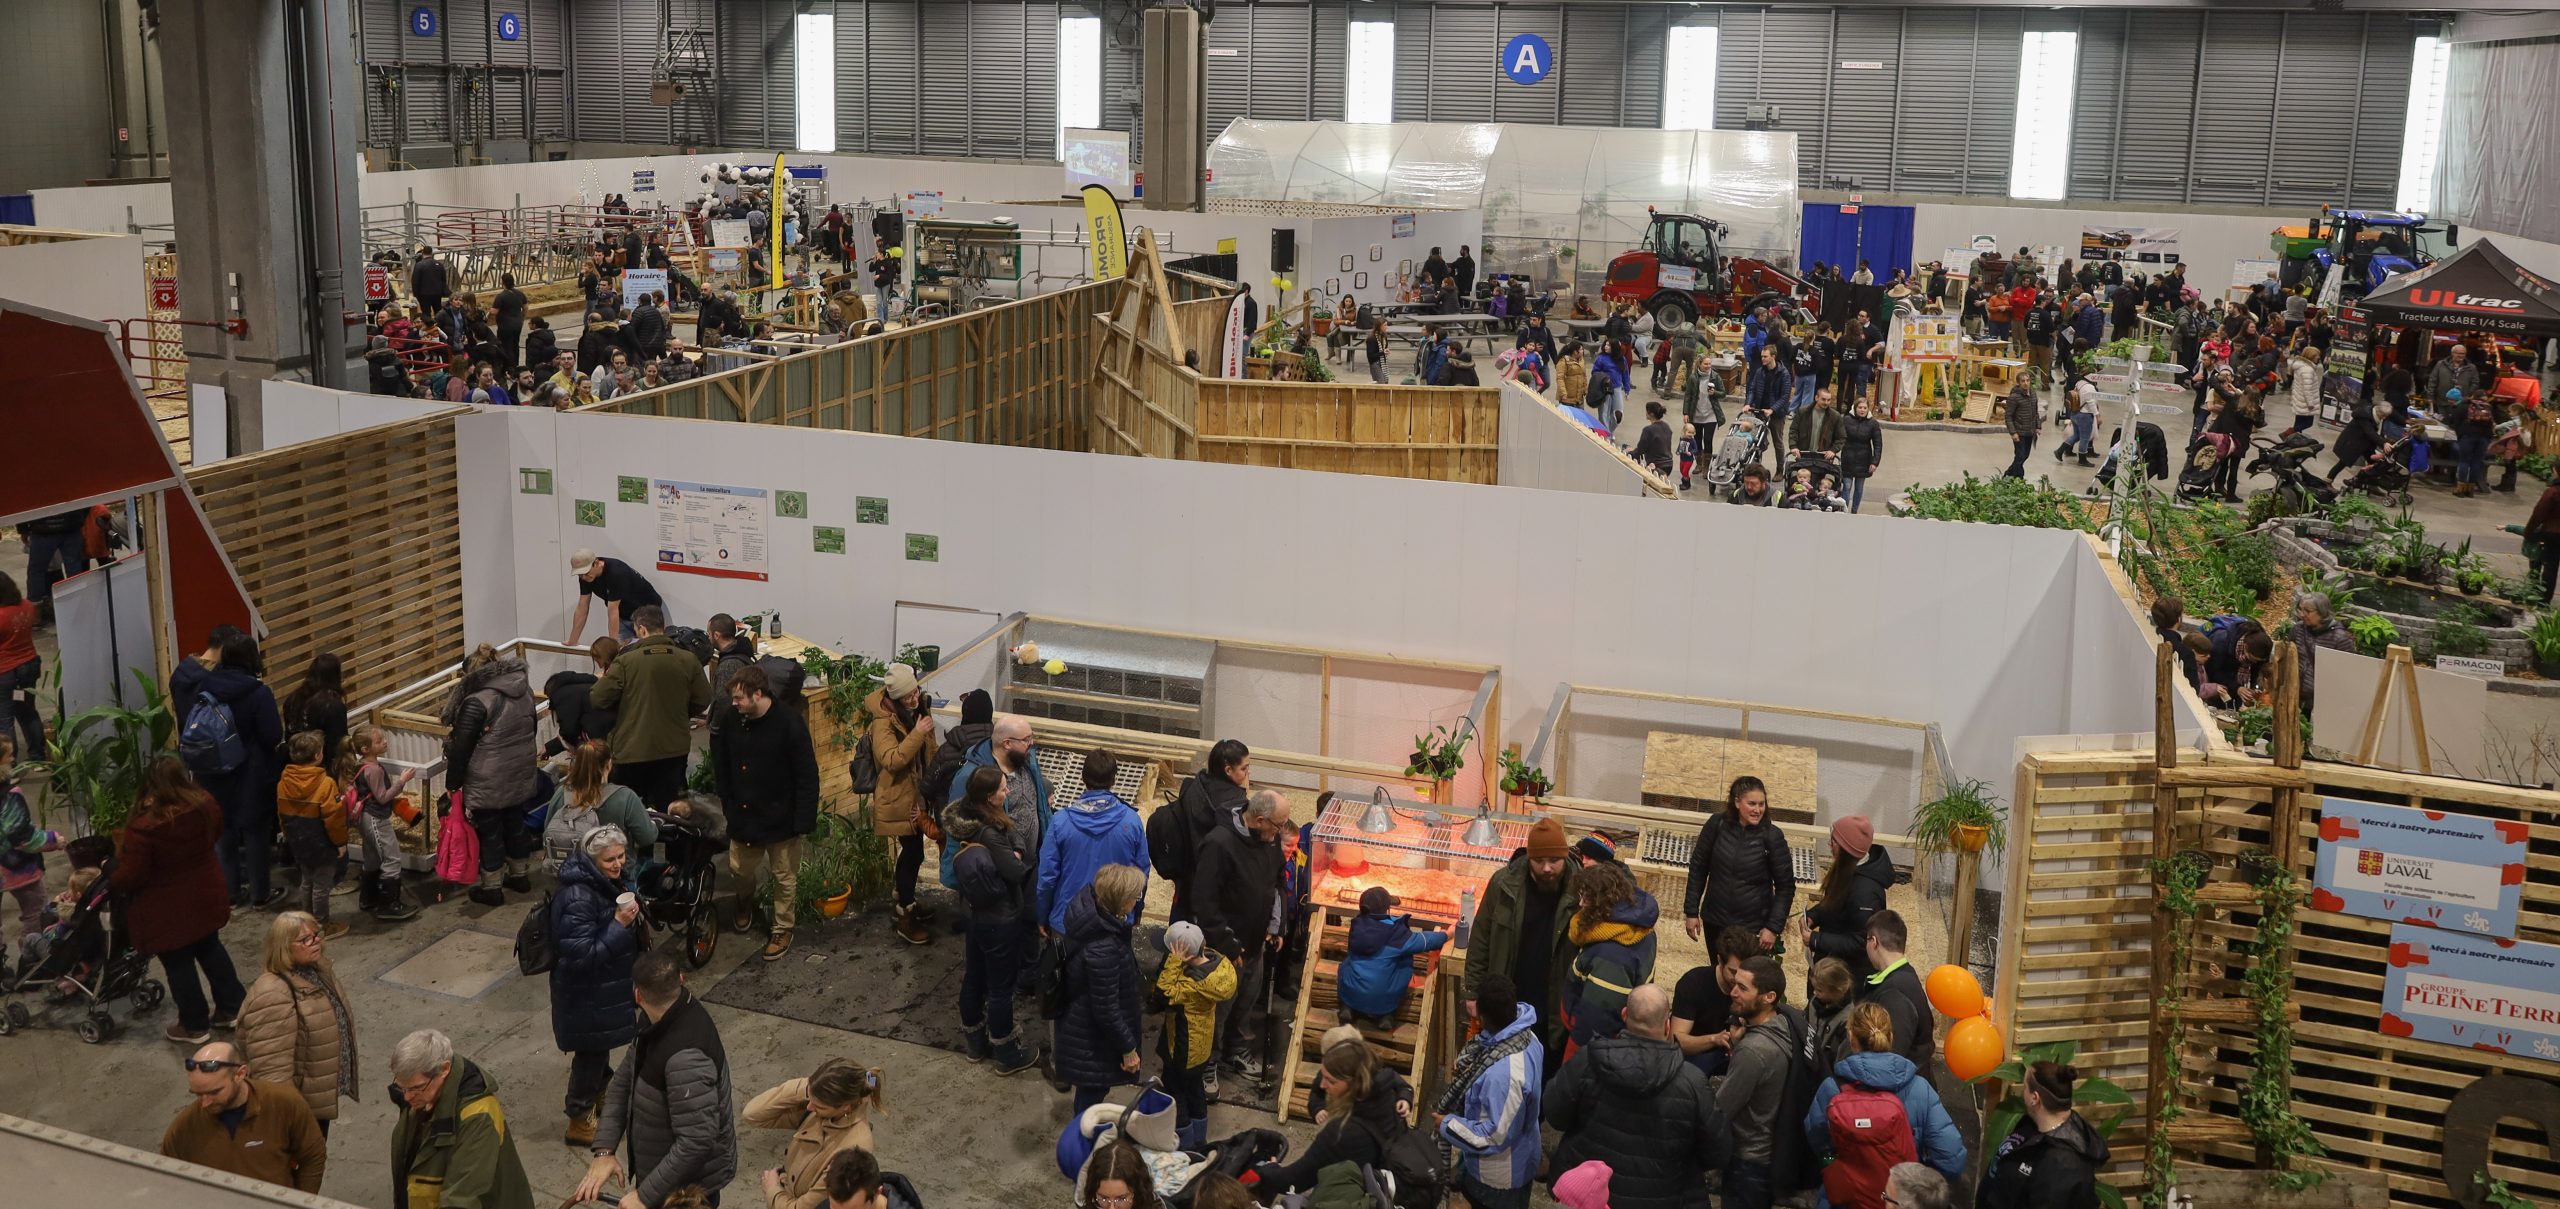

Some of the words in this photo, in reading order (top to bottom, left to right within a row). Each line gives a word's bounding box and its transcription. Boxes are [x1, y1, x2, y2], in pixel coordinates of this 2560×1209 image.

[420, 13, 430, 30] 5
[505, 19, 514, 35] 6
[1513, 44, 1540, 74] A
[2409, 288, 2524, 312] ULtrac
[2400, 311, 2441, 323] Tracteur
[2442, 315, 2476, 326] ASABE
[2479, 318, 2495, 328] 1/4
[2498, 320, 2526, 330] Scale
[2438, 657, 2502, 671] PERMACON
[2360, 818, 2390, 828] Merci
[2390, 820, 2397, 829] à
[2398, 823, 2428, 833] notre
[2427, 827, 2485, 841] partenaire
[2386, 863, 2432, 881] LAVAL
[2430, 944, 2460, 954] Merci
[2460, 947, 2467, 956] à
[2468, 950, 2497, 960] notre
[2497, 955, 2555, 969] partenaire
[2420, 983, 2466, 996] GROUPE
